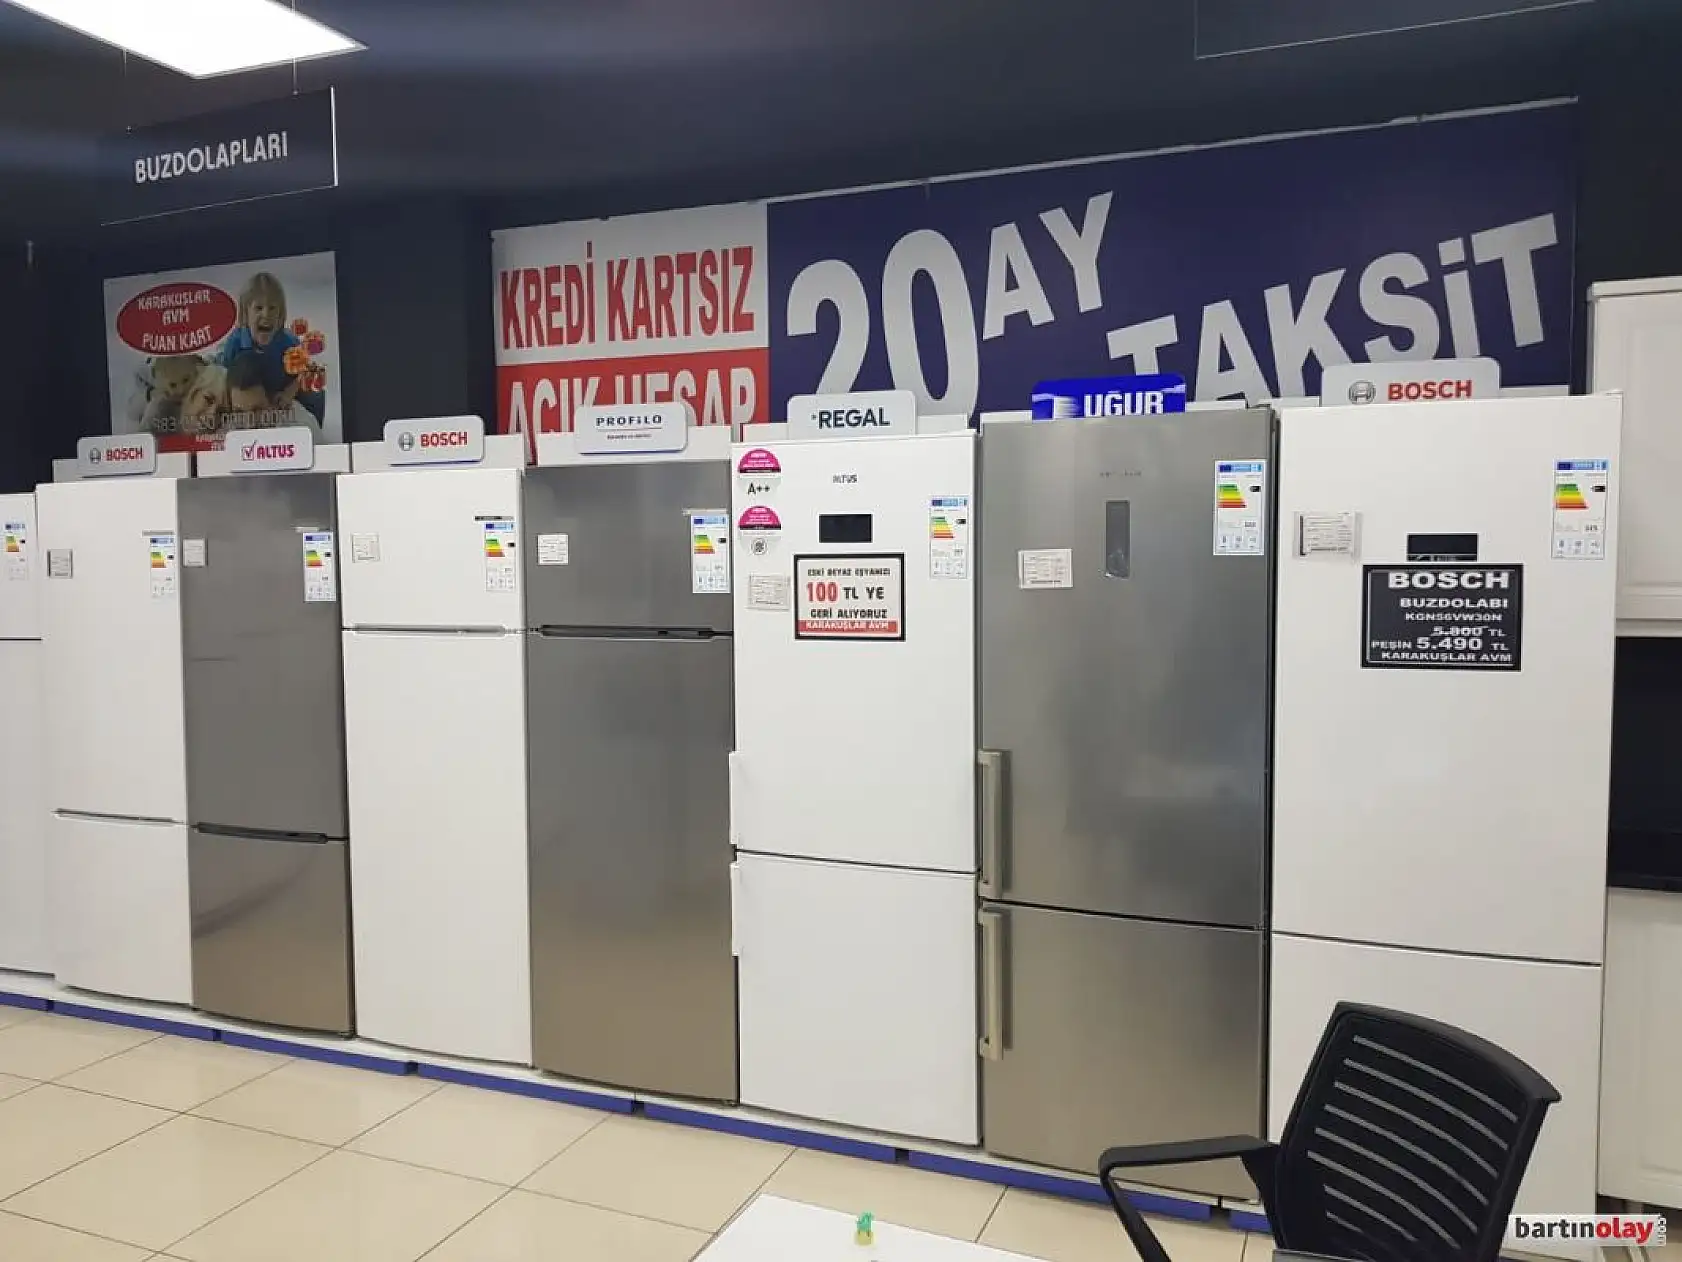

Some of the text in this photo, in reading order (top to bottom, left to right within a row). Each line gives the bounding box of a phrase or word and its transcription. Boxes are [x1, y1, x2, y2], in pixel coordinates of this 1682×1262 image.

[135, 131, 288, 183] BUZDOLAPLARI
[501, 240, 755, 350] KREDİ KARTSIZ
[162, 307, 189, 326] AVM
[786, 190, 1113, 436] 20 AY
[141, 325, 212, 351] PUAN KART
[1388, 379, 1472, 401] BOSCH
[818, 407, 890, 429] REGAL
[420, 431, 468, 447] BOSCH
[105, 445, 143, 460] BOSCH
[256, 444, 295, 459] ALTUS
[747, 482, 771, 496] A++
[1388, 571, 1509, 589] BOSCH
[807, 581, 839, 602] 100
[842, 586, 859, 600] TL
[865, 586, 885, 600] YE
[1400, 597, 1508, 608] BUZDOLABI
[837, 608, 888, 619] ALIYORUZ
[1487, 628, 1507, 637] TL
[1416, 636, 1483, 651] 5.490
[1490, 642, 1509, 651] TL
[1479, 653, 1512, 662] AVM
